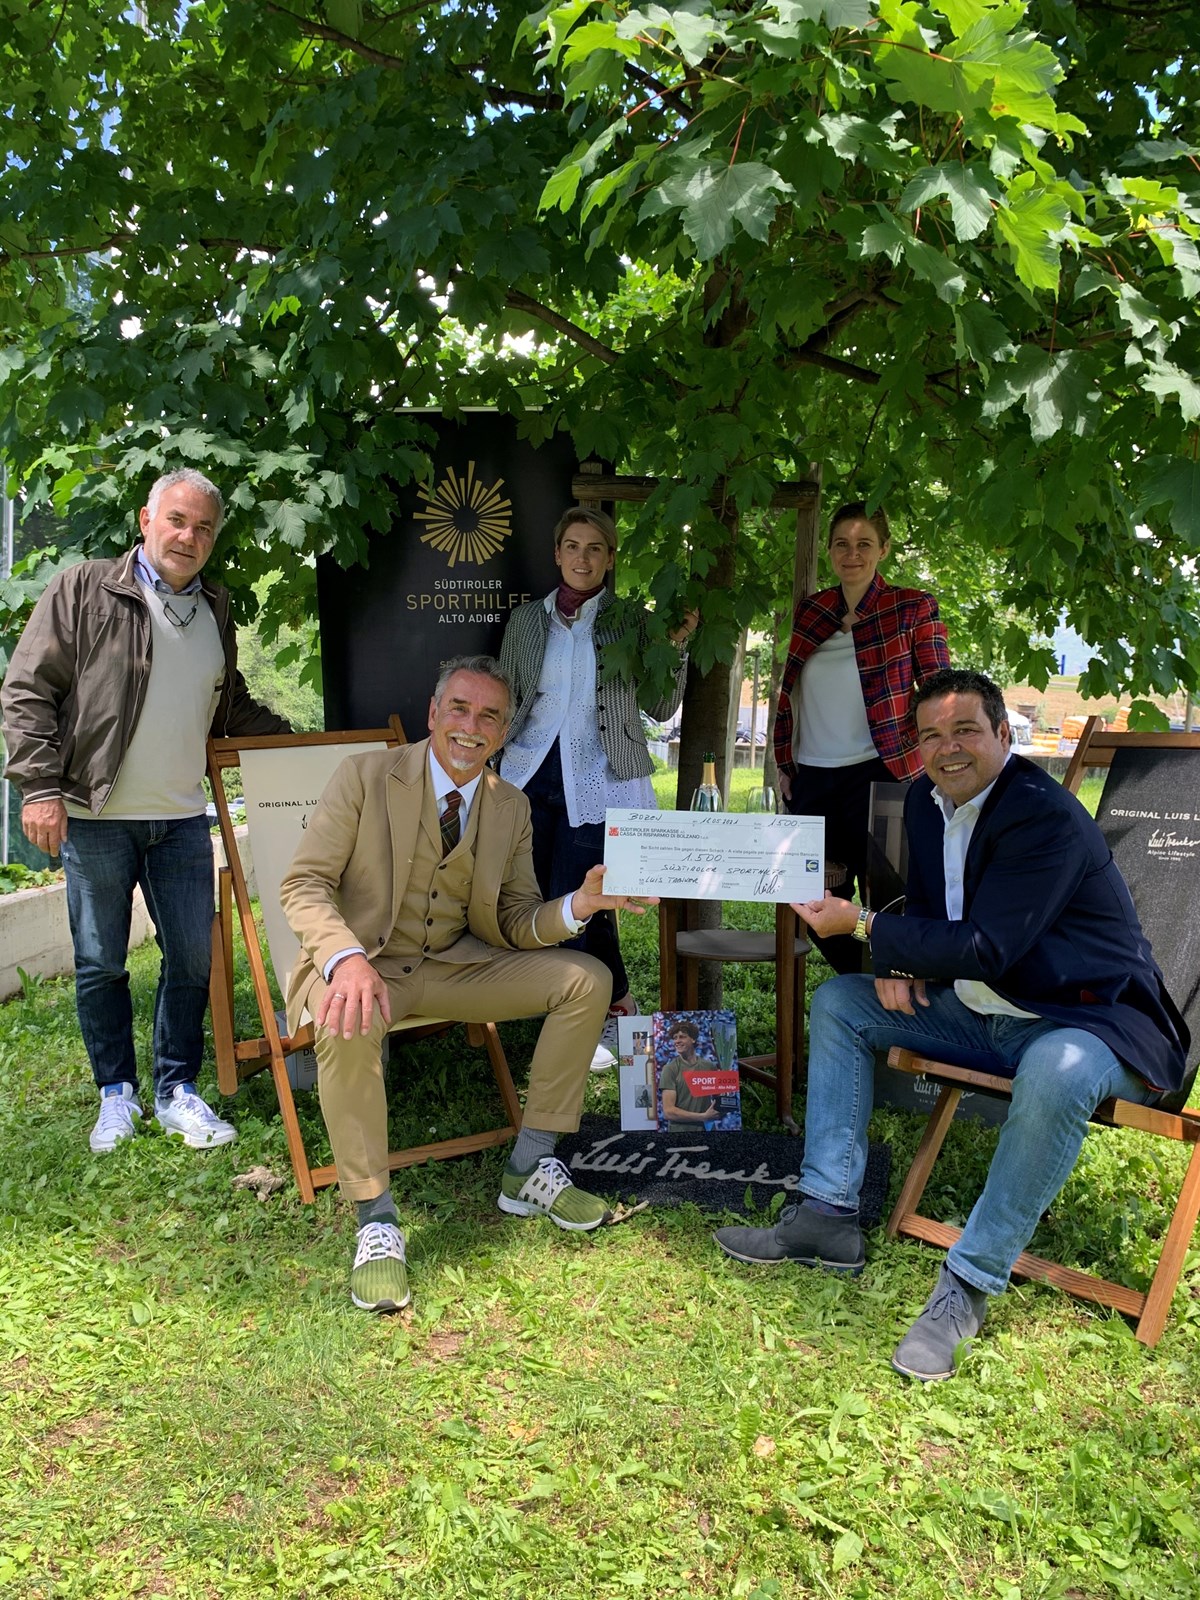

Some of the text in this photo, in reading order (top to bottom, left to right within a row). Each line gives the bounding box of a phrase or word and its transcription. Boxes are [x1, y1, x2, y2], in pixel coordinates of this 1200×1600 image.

[434, 579, 502, 590] SÜDTIROLER
[438, 614, 501, 623] ALTO ADIGE
[258, 800, 303, 808] ORIGINAL
[1110, 809, 1161, 819] ORIGINAL
[1164, 812, 1191, 821] LUIS
[692, 1077, 717, 1085] SPORT
[569, 1134, 657, 1175] Luis
